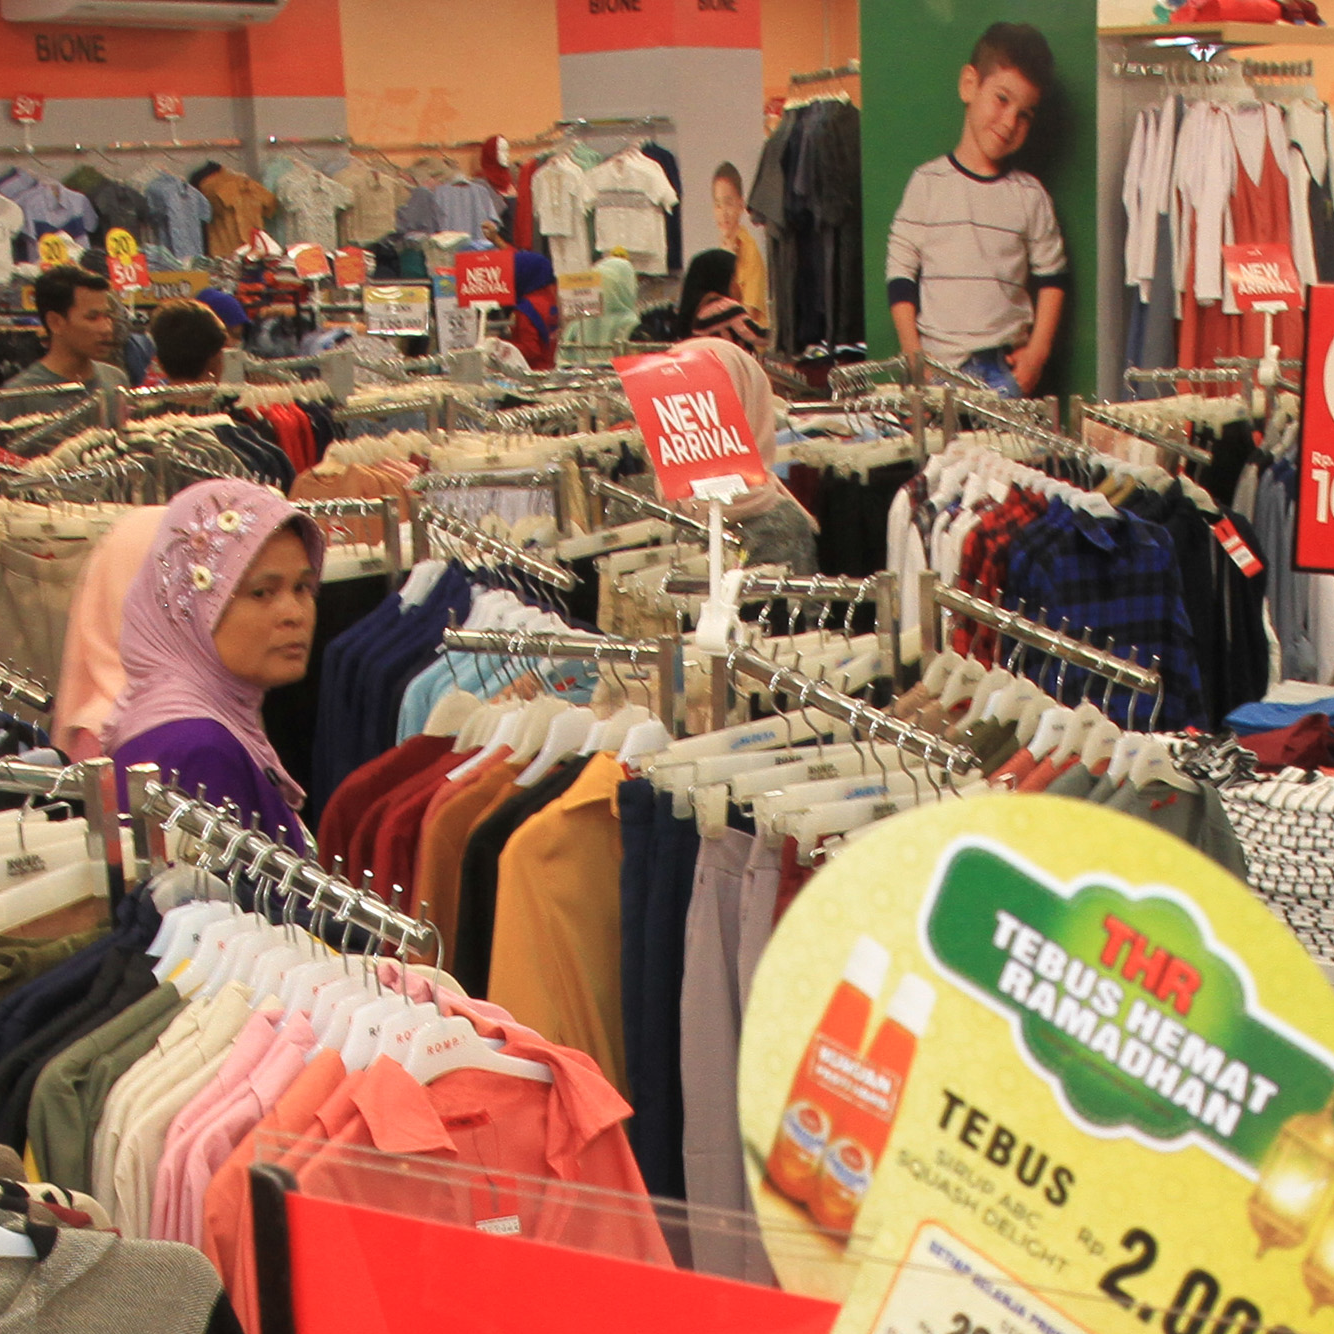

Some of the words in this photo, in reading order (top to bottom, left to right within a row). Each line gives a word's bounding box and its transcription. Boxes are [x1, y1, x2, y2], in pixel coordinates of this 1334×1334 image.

[35, 34, 107, 63] BIONE
[1238, 262, 1280, 280] NEW
[1238, 277, 1296, 295] ARRIVAL
[651, 390, 722, 434] NEW
[658, 425, 750, 467] ARRIVAL
[1100, 913, 1202, 1016] THR
[992, 909, 1124, 1018] TEBUS
[1124, 999, 1280, 1114] HEMAT
[997, 958, 1242, 1138] RAMADHAN
[933, 1147, 995, 1197] SIRUP
[997, 1184, 1046, 1231] ABC
[934, 1088, 1077, 1208] TEBUS
[897, 1149, 978, 1213] SQUASH
[981, 1202, 1069, 1275] DELIGHT
